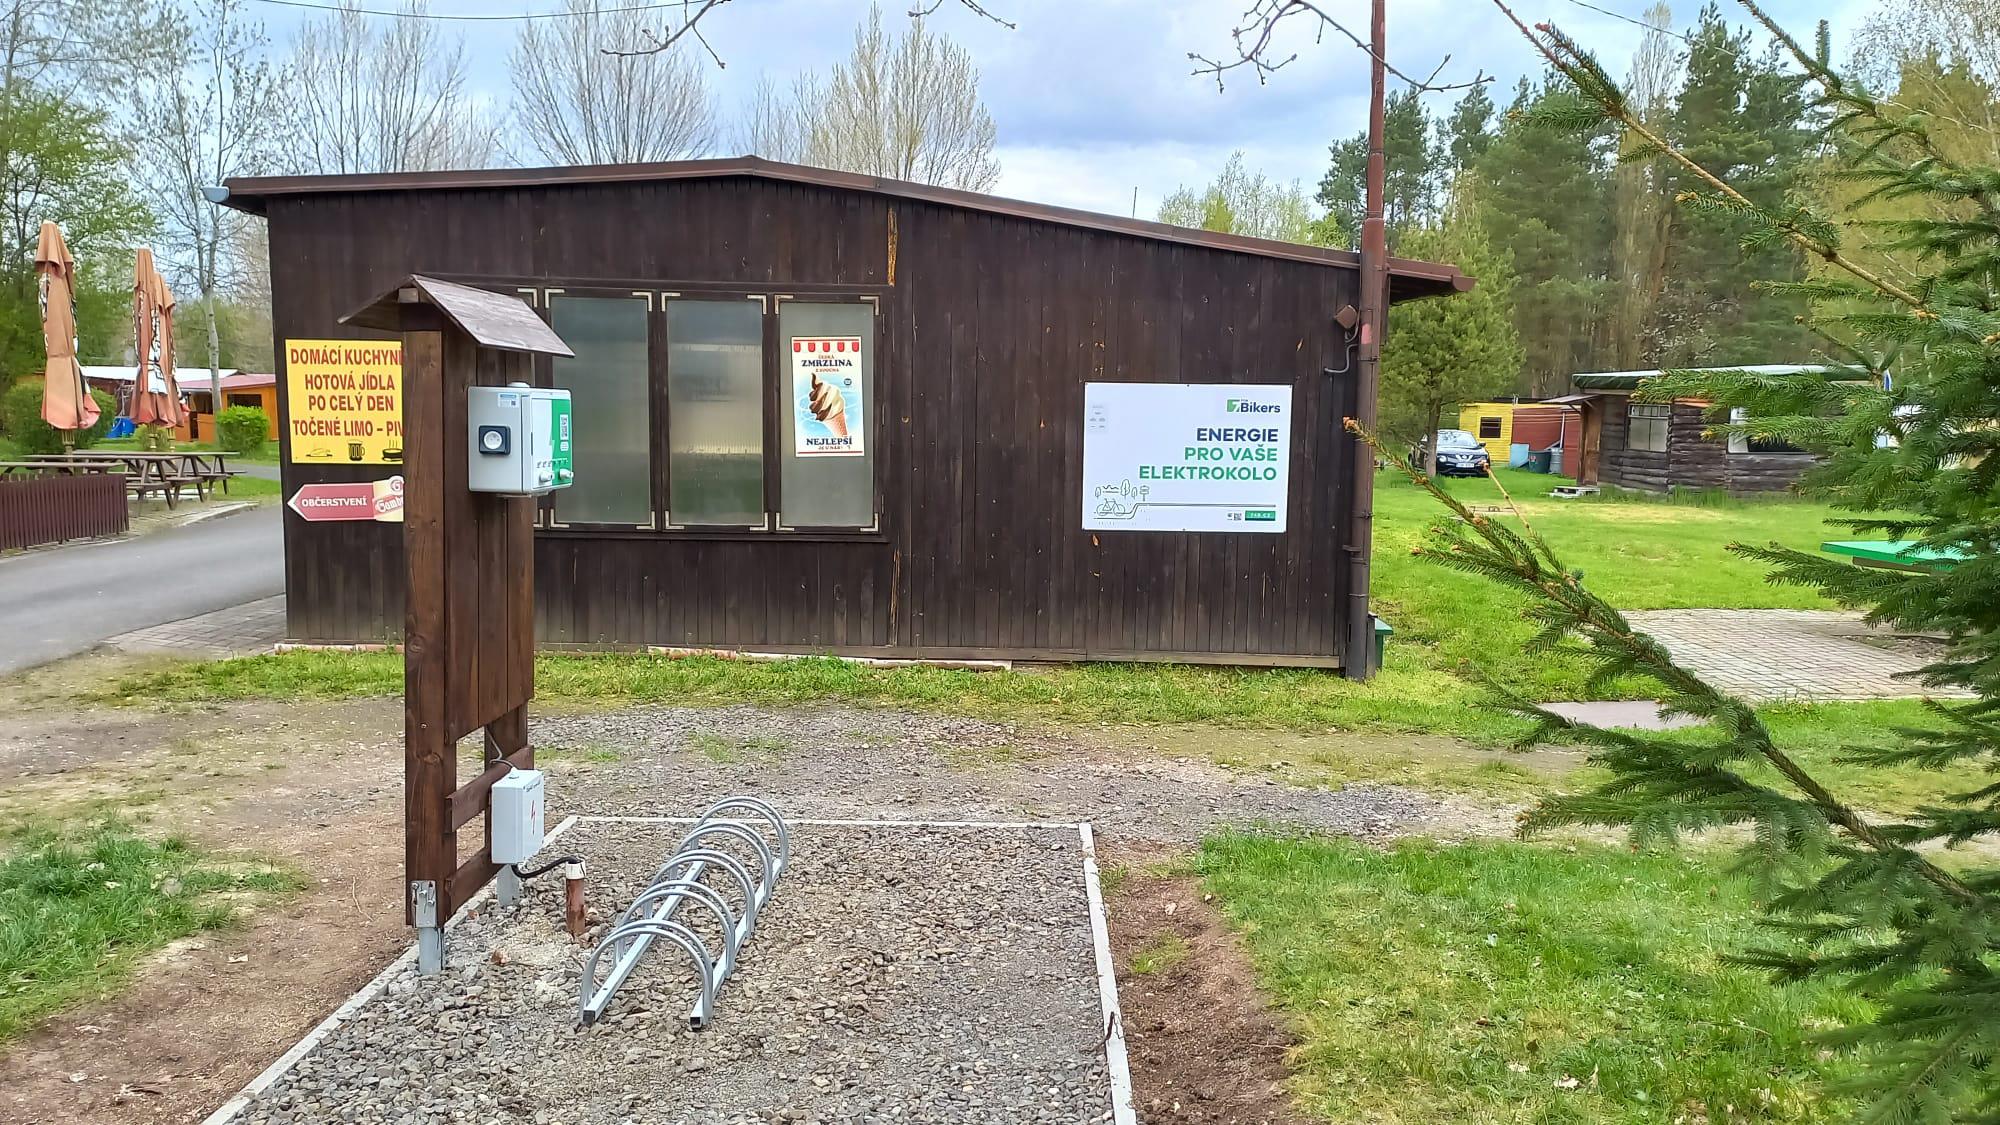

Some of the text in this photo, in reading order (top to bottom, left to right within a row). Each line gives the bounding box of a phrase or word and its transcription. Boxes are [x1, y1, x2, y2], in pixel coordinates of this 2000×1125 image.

[290, 344, 342, 364] DOMÁCÍ
[801, 359, 853, 367] ZMRZLINA
[304, 370, 395, 390] HOTOVÁ JÍDLA
[308, 391, 394, 411] PO CELÝ DEN
[293, 416, 340, 436] TOČENÉ
[344, 420, 373, 437] LIMO
[1196, 427, 1279, 443] ENERGIE
[806, 435, 852, 446] NEJLEPŠÍ
[1184, 443, 1278, 462] PRO VAŠE
[1139, 465, 1277, 481] ELEKTROKOLO
[301, 496, 368, 507] OBČERSTVENÍ
